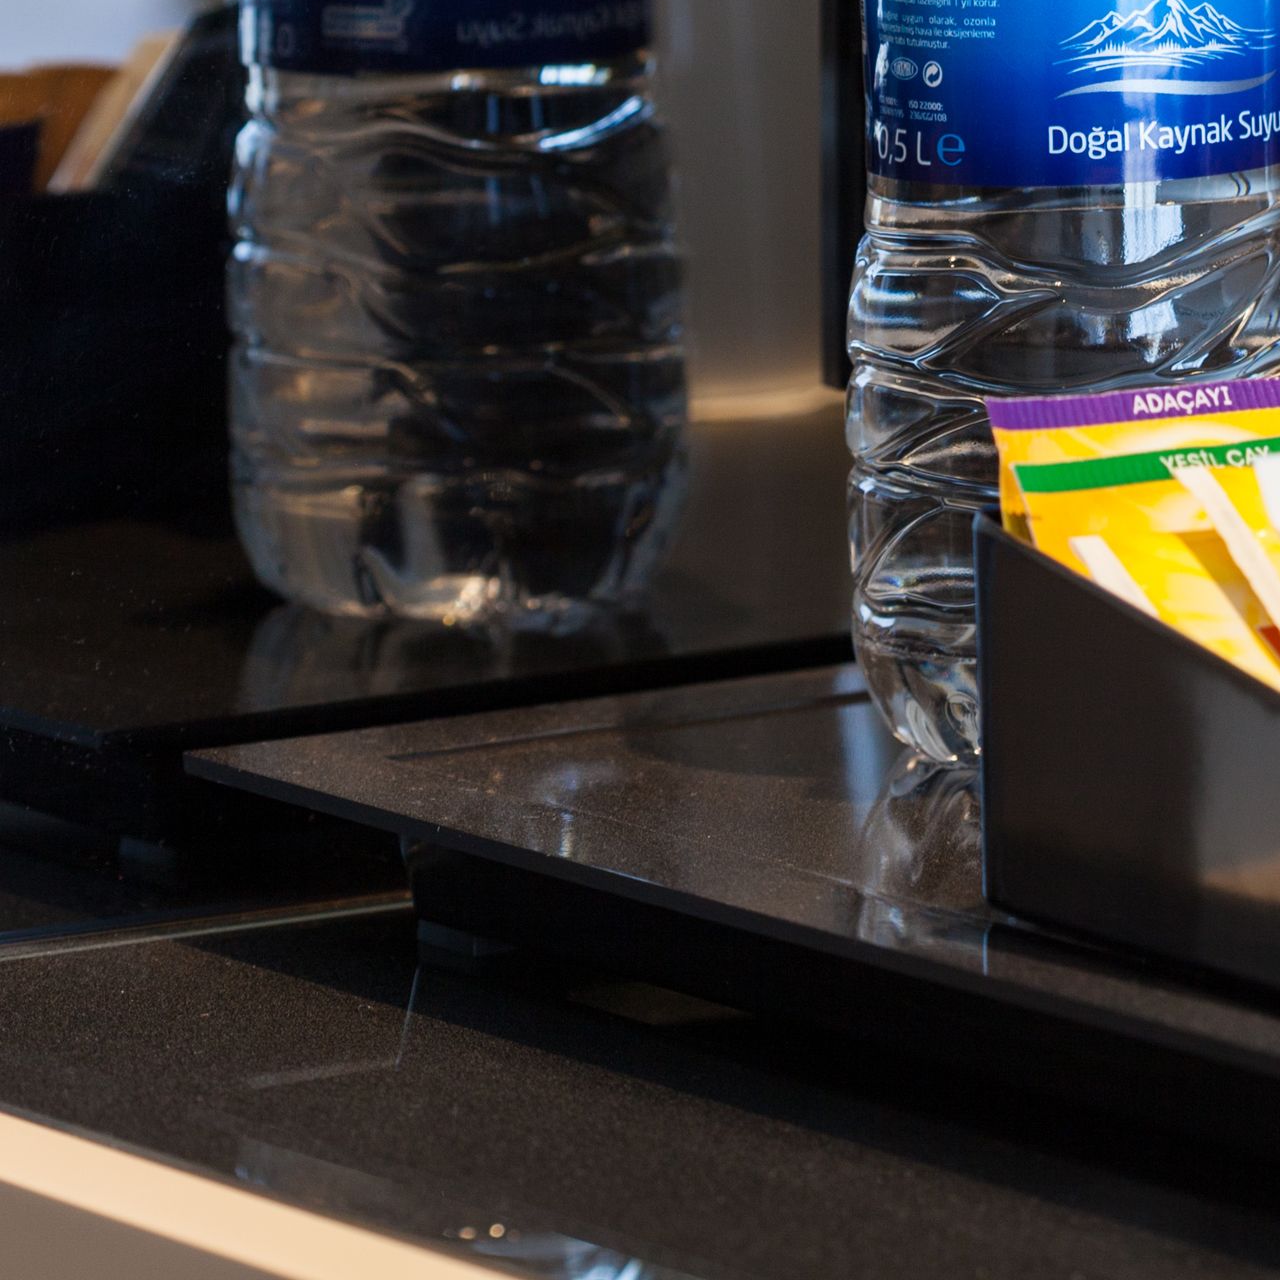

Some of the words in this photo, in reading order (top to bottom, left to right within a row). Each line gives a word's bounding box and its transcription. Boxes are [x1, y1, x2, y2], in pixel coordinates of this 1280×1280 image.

[963, 17, 996, 27] ozonla
[878, 125, 907, 165] 0,5
[916, 131, 932, 166] L
[1047, 122, 1129, 160] Doğal
[1139, 114, 1233, 154] Kaynak
[1133, 385, 1232, 415] ADAÇAYI
